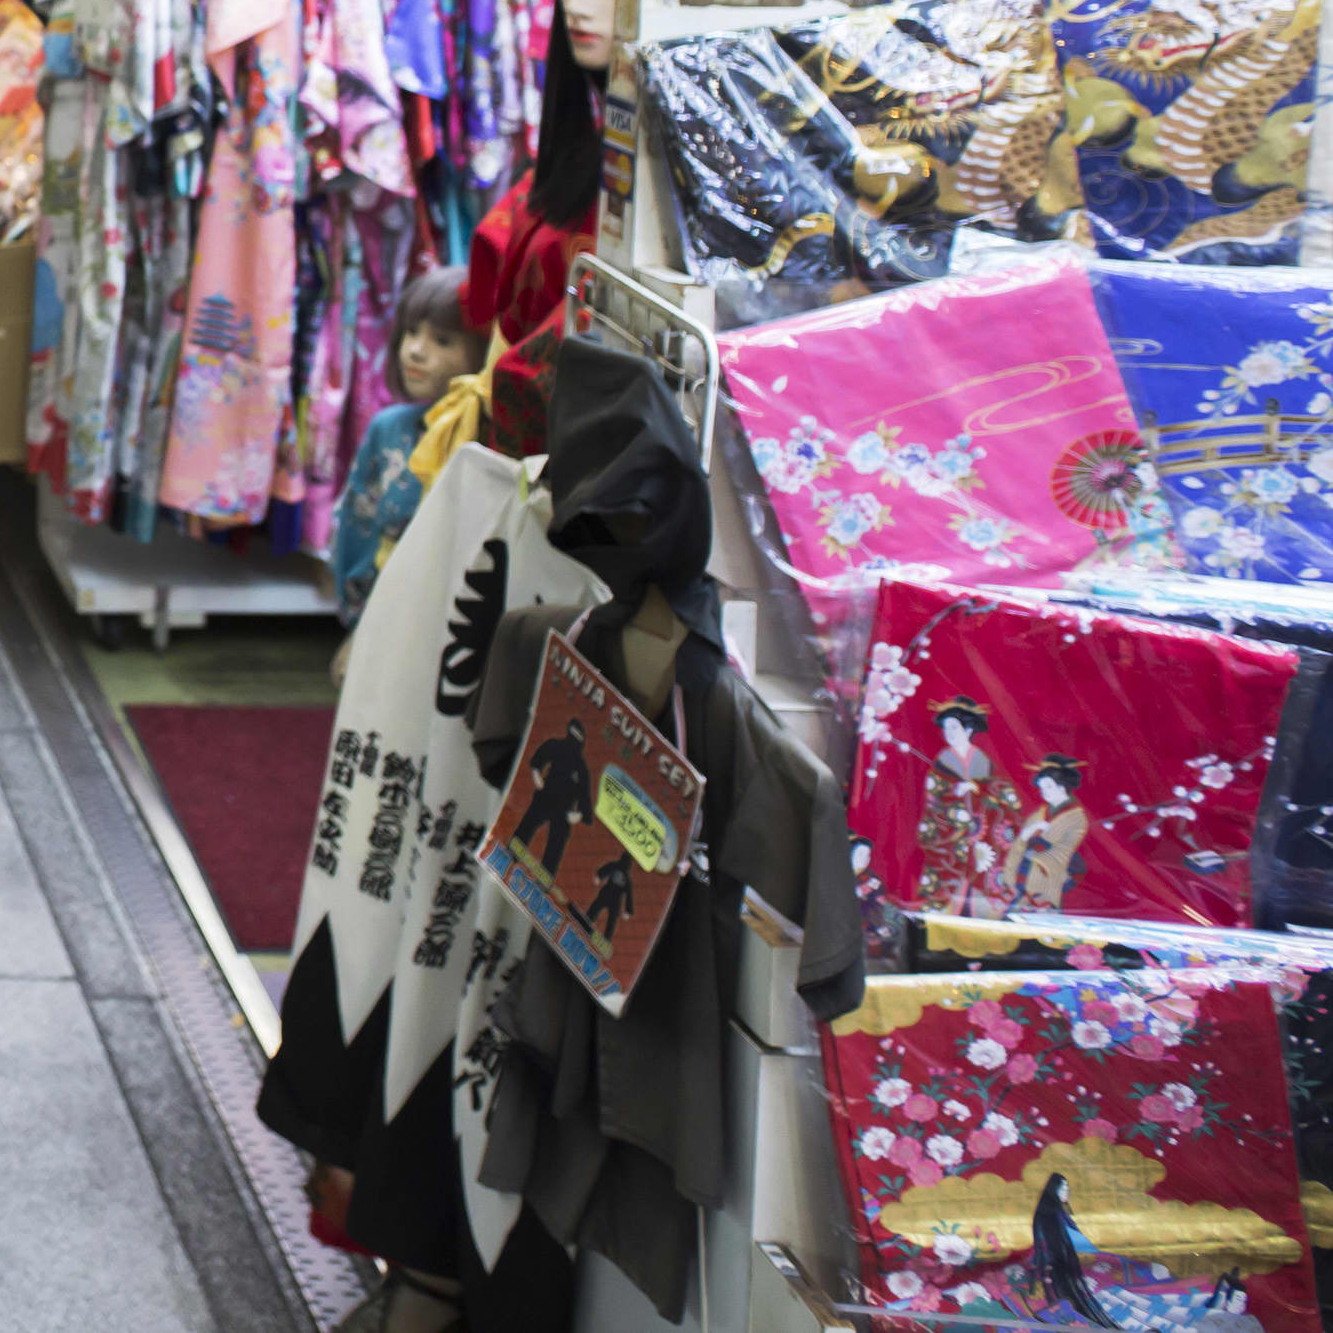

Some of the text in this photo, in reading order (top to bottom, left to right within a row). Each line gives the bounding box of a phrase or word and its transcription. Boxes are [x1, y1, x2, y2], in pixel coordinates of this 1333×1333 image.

[549, 645, 606, 709] NINJA
[610, 705, 654, 754] SUIT
[658, 754, 695, 798] SET
